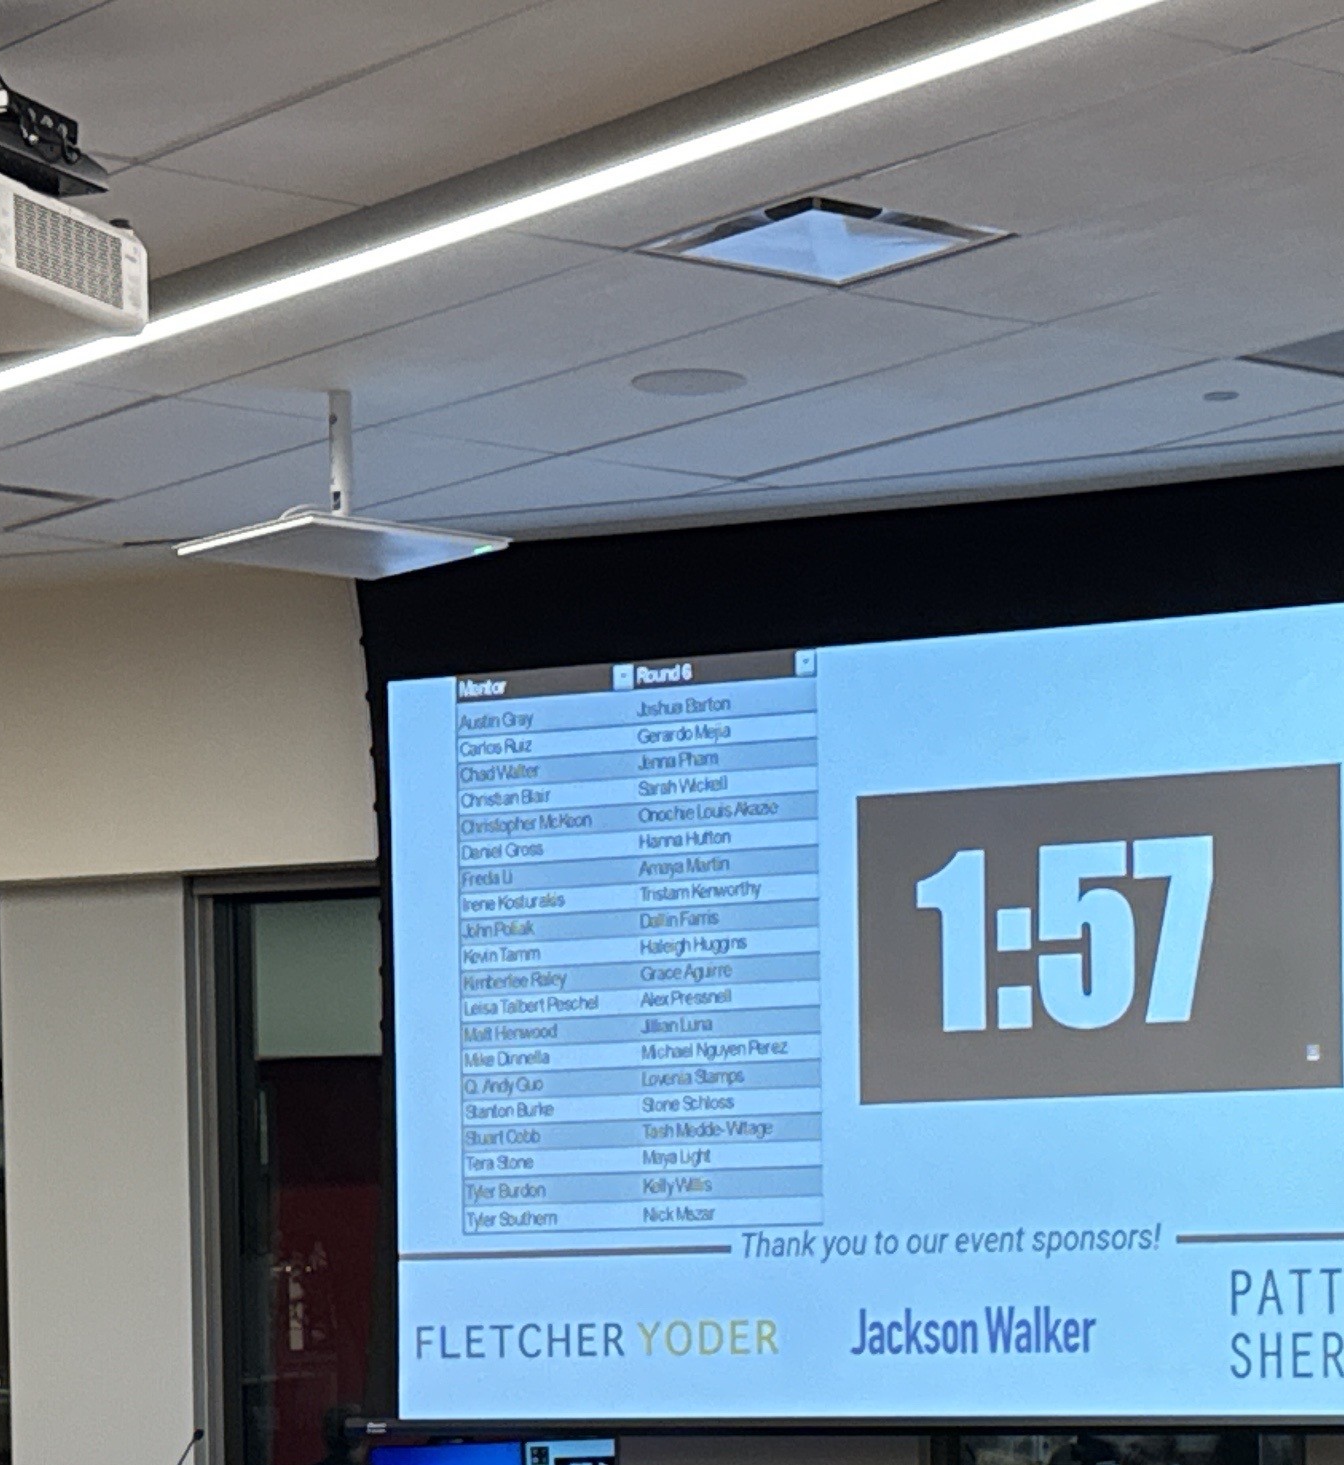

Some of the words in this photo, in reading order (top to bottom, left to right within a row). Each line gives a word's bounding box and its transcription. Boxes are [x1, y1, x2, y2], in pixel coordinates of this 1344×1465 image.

[637, 664, 680, 684] Round
[682, 663, 692, 681] 6
[459, 679, 506, 697] Mentor
[637, 701, 682, 716] Joshua
[686, 697, 731, 712] Barton
[460, 714, 500, 730] Austin
[502, 711, 533, 729] Gray
[638, 726, 692, 744] Gerardo
[695, 723, 731, 744] Mejia
[460, 741, 502, 756] Carlos
[505, 738, 532, 754] Ruiz
[638, 754, 675, 770] Jenna
[678, 752, 718, 767] Pham
[460, 765, 495, 783] Chad
[638, 780, 676, 796] Sarah
[461, 791, 519, 808] Christian
[521, 788, 551, 804] Blair
[638, 805, 694, 823] Onochie
[697, 804, 732, 818] Louis
[461, 817, 536, 837] Christopher
[638, 834, 683, 848] Hanna
[462, 844, 502, 860] Daniel
[506, 842, 544, 857] Gross
[638, 861, 683, 878] Amaya
[686, 857, 730, 873] Martin
[461, 871, 500, 886] Freda
[692, 880, 761, 899] Kenworthy
[463, 898, 495, 912] Irene
[462, 923, 492, 938] John
[916, 835, 1214, 1034] 1:57
[693, 936, 747, 955] Huggins
[463, 949, 498, 964] Kevin
[500, 947, 541, 962] Tamm
[640, 966, 682, 981] Grace
[684, 963, 732, 982] Aguirre
[640, 992, 669, 1007] Alex
[464, 1027, 492, 1041] Matt
[680, 1018, 712, 1032] Luna
[641, 1044, 693, 1060] Michael
[696, 1042, 745, 1061] Nguyen
[748, 1040, 788, 1055] Perez
[464, 1053, 494, 1067] Mike
[482, 1078, 514, 1097] Andy
[516, 1077, 543, 1092] Guo
[466, 1104, 514, 1120] Stanton
[517, 1102, 554, 1118] Burke
[642, 1097, 680, 1112] Stone
[683, 1095, 735, 1111] Schloss
[466, 1130, 503, 1146] Stuart
[506, 1129, 540, 1144] Cobb
[643, 1124, 674, 1139] Tash
[466, 1156, 494, 1171] Tera
[497, 1155, 534, 1169] Stone
[643, 1150, 677, 1169] Maya
[680, 1148, 711, 1167] Light
[466, 1184, 495, 1203] Tyler
[498, 1183, 546, 1198] Burdon
[643, 1178, 675, 1196] Kelly
[466, 1212, 496, 1231] Tyler
[499, 1210, 558, 1226] Southern
[643, 1207, 674, 1222] Nick
[742, 1232, 816, 1260] Thank
[821, 1235, 866, 1265] you
[874, 1231, 898, 1256] to
[906, 1234, 946, 1256] our
[954, 1229, 1025, 1255] event
[1032, 1224, 1162, 1259] sponsors!
[850, 1308, 978, 1355] Jackson
[984, 1305, 1097, 1353] Walker
[415, 1322, 624, 1360] FLETCHER
[637, 1319, 779, 1359] YODER
